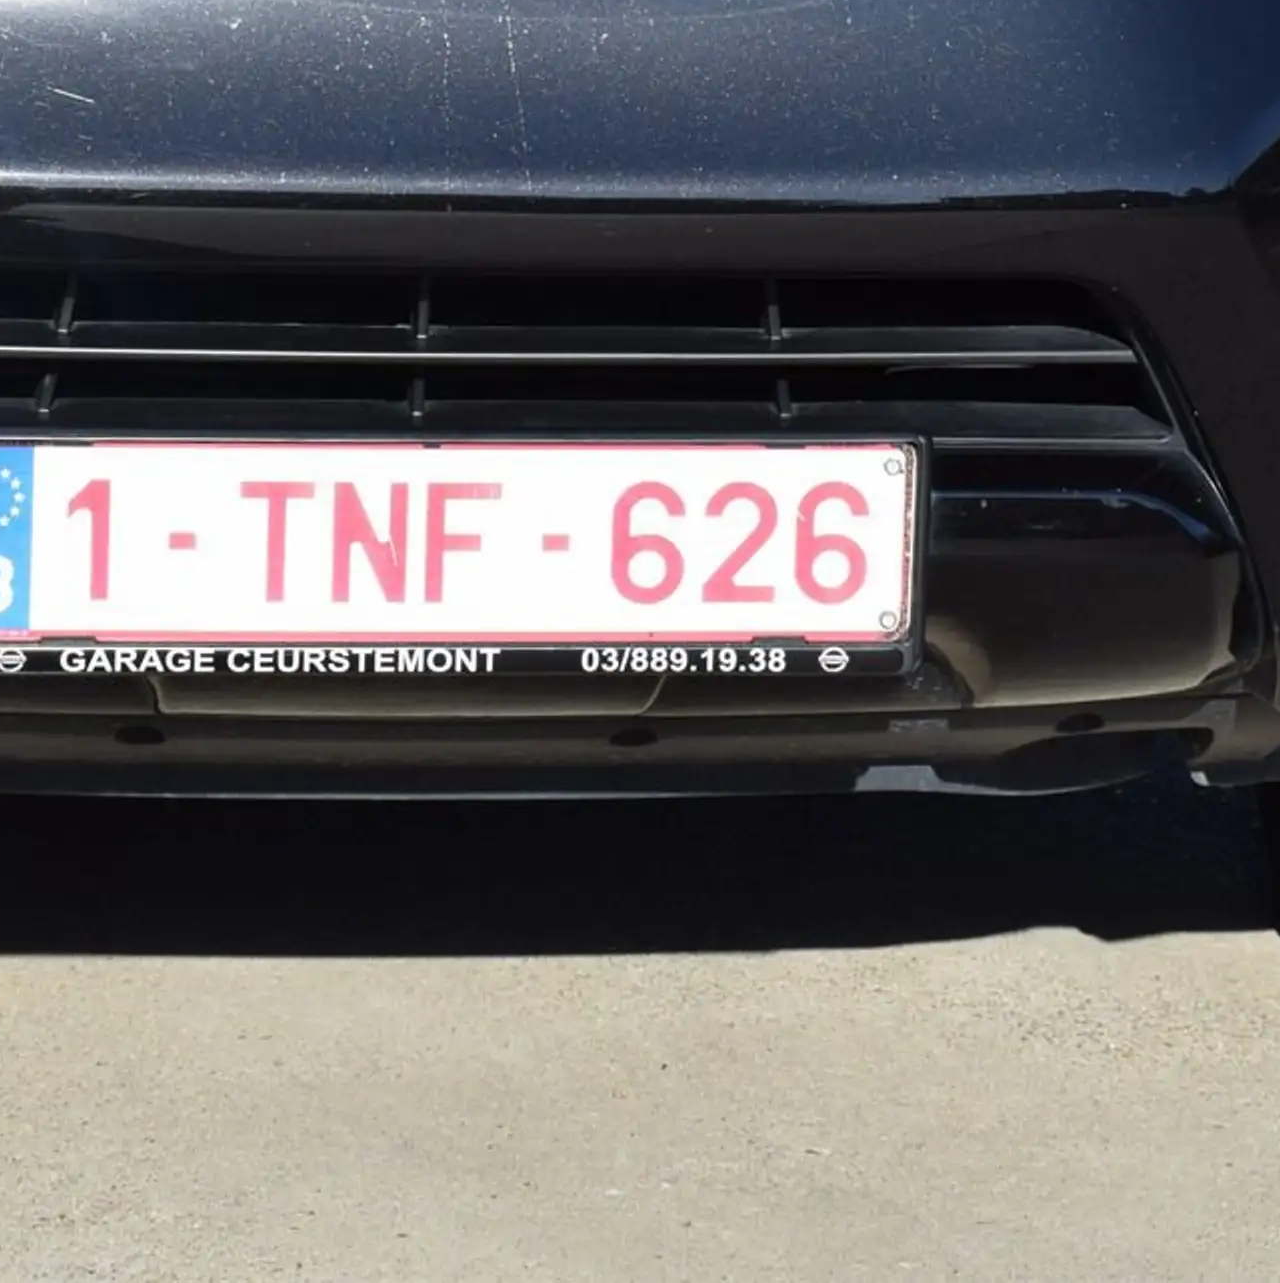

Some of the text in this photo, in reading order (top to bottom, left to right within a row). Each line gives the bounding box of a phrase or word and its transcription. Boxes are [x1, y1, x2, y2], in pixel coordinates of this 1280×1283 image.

[60, 648, 501, 673] GARAGE CEURSTEMONT
[581, 648, 787, 673] 03/889.19.38
